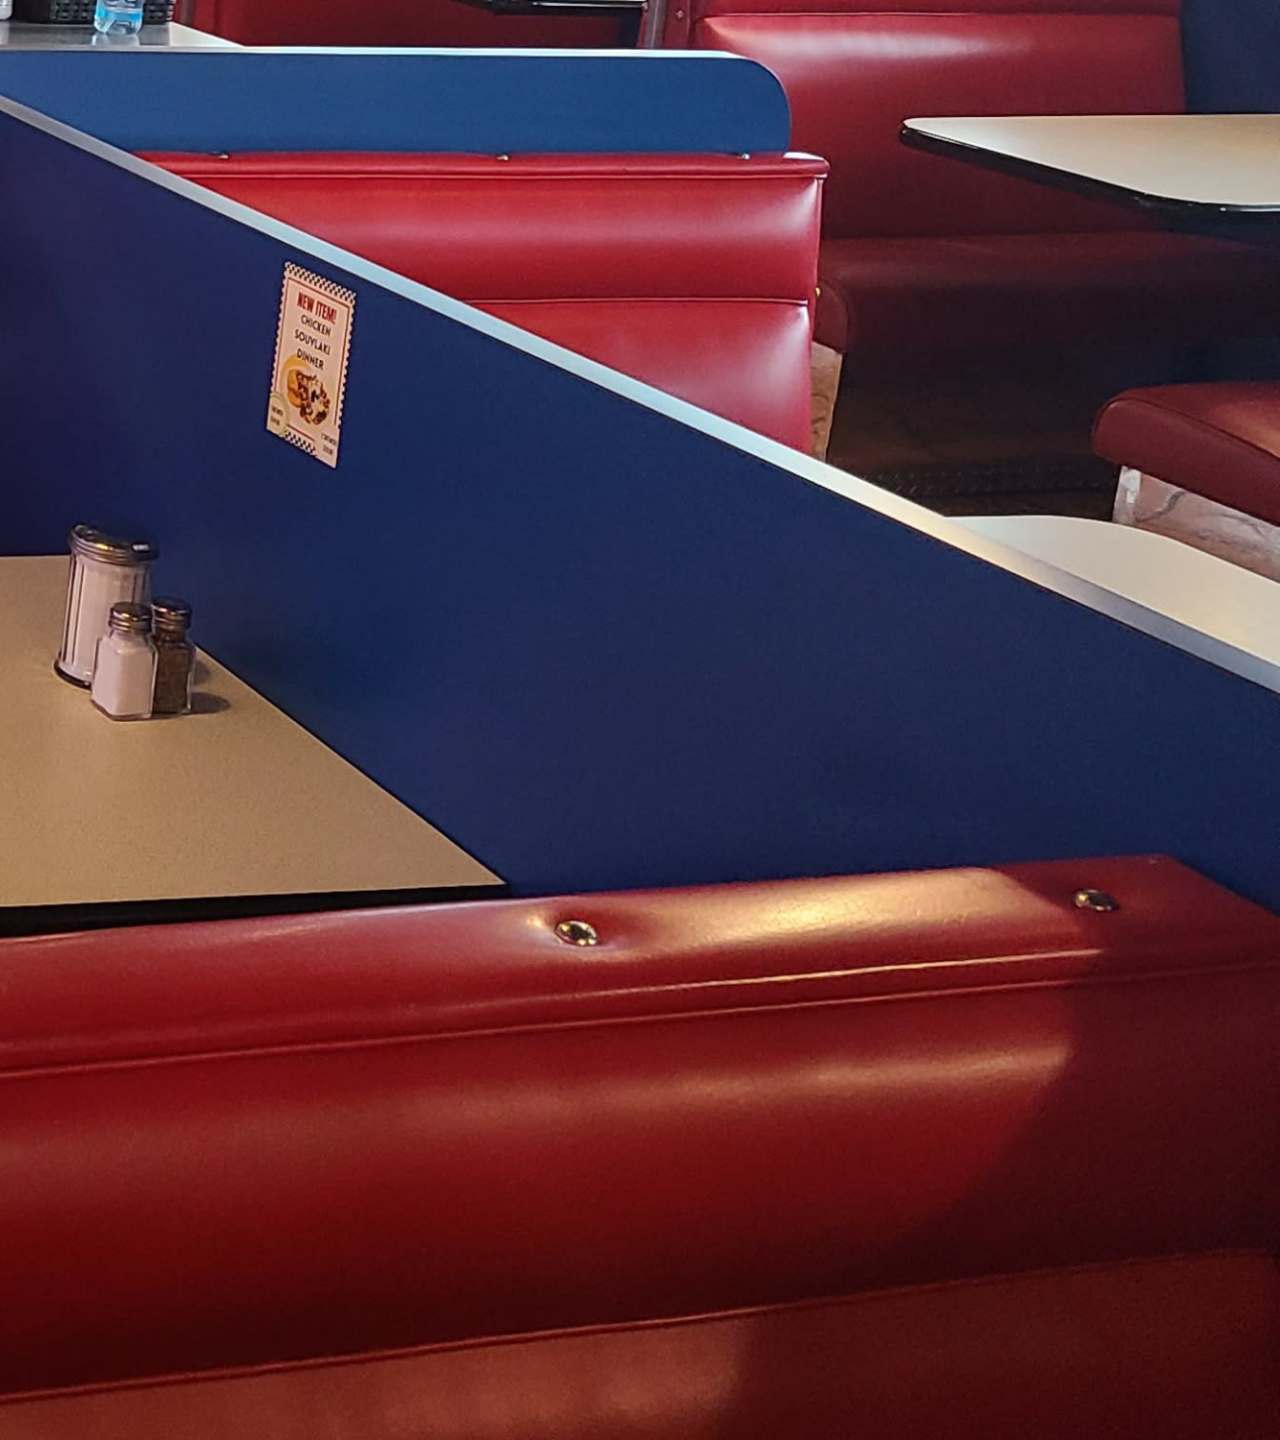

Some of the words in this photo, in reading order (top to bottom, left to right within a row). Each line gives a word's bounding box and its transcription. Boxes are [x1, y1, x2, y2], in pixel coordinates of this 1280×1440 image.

[297, 291, 315, 314] NEW
[301, 314, 332, 337] CHICKEN
[294, 328, 331, 356] SOUVLAKI
[296, 348, 325, 370] DINNER
